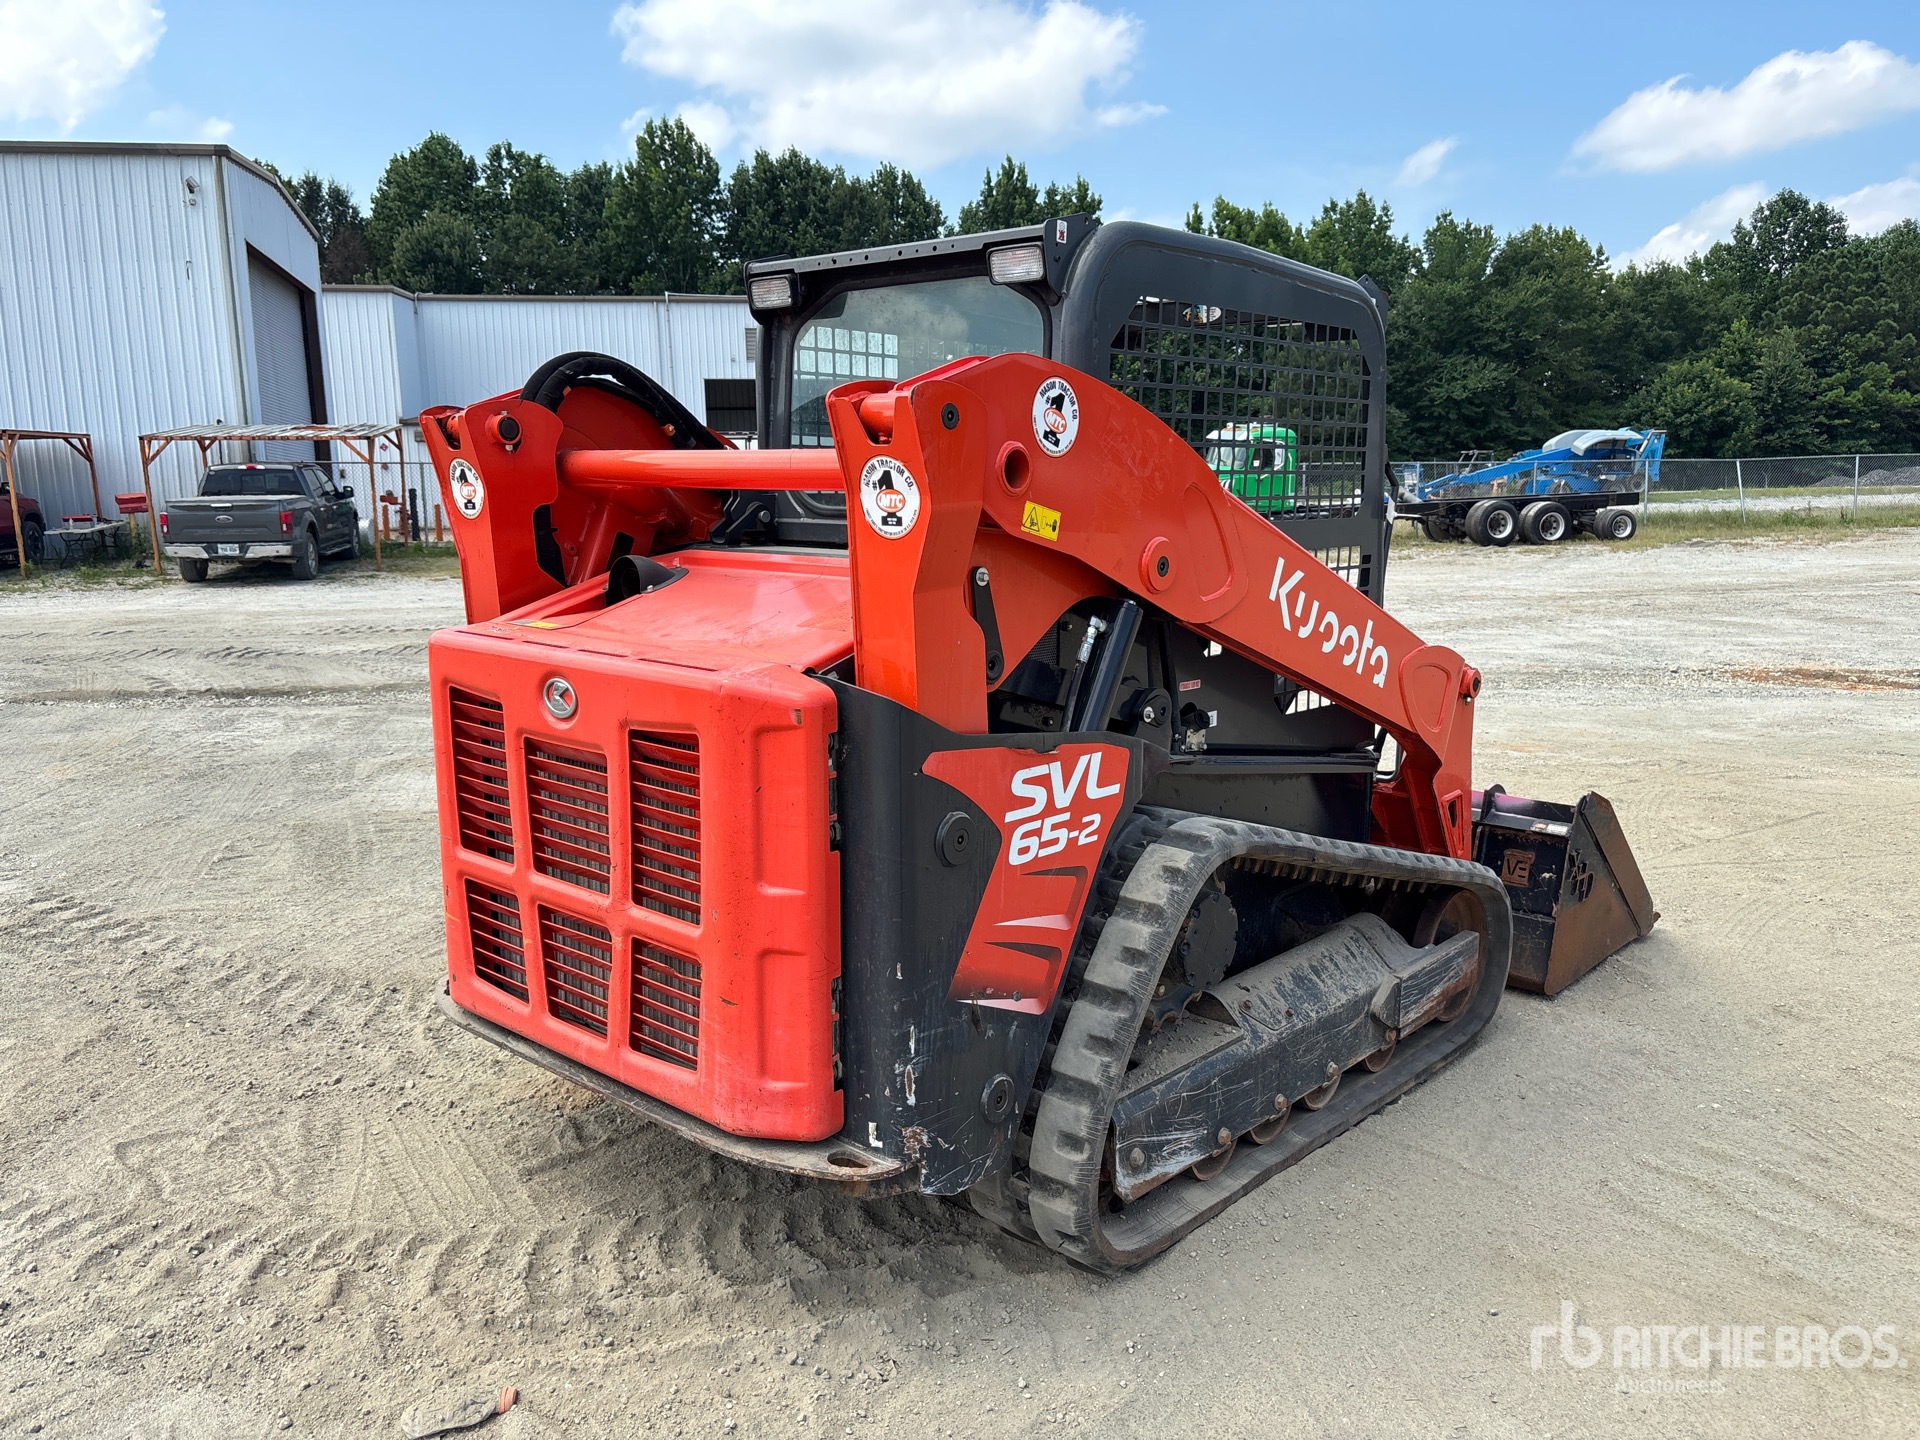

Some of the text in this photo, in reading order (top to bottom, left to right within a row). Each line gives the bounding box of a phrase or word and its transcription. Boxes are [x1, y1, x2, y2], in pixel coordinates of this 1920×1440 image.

[1039, 380, 1057, 399] MASON
[1057, 381, 1076, 408] TRACTOR
[1046, 411, 1066, 431] MTC
[863, 459, 914, 491] MASON TRACTOR CO.
[880, 493, 903, 508] MTC
[1269, 556, 1389, 689] Kubota
[1004, 751, 1121, 823] SVL
[1008, 811, 1102, 866] 65-2
